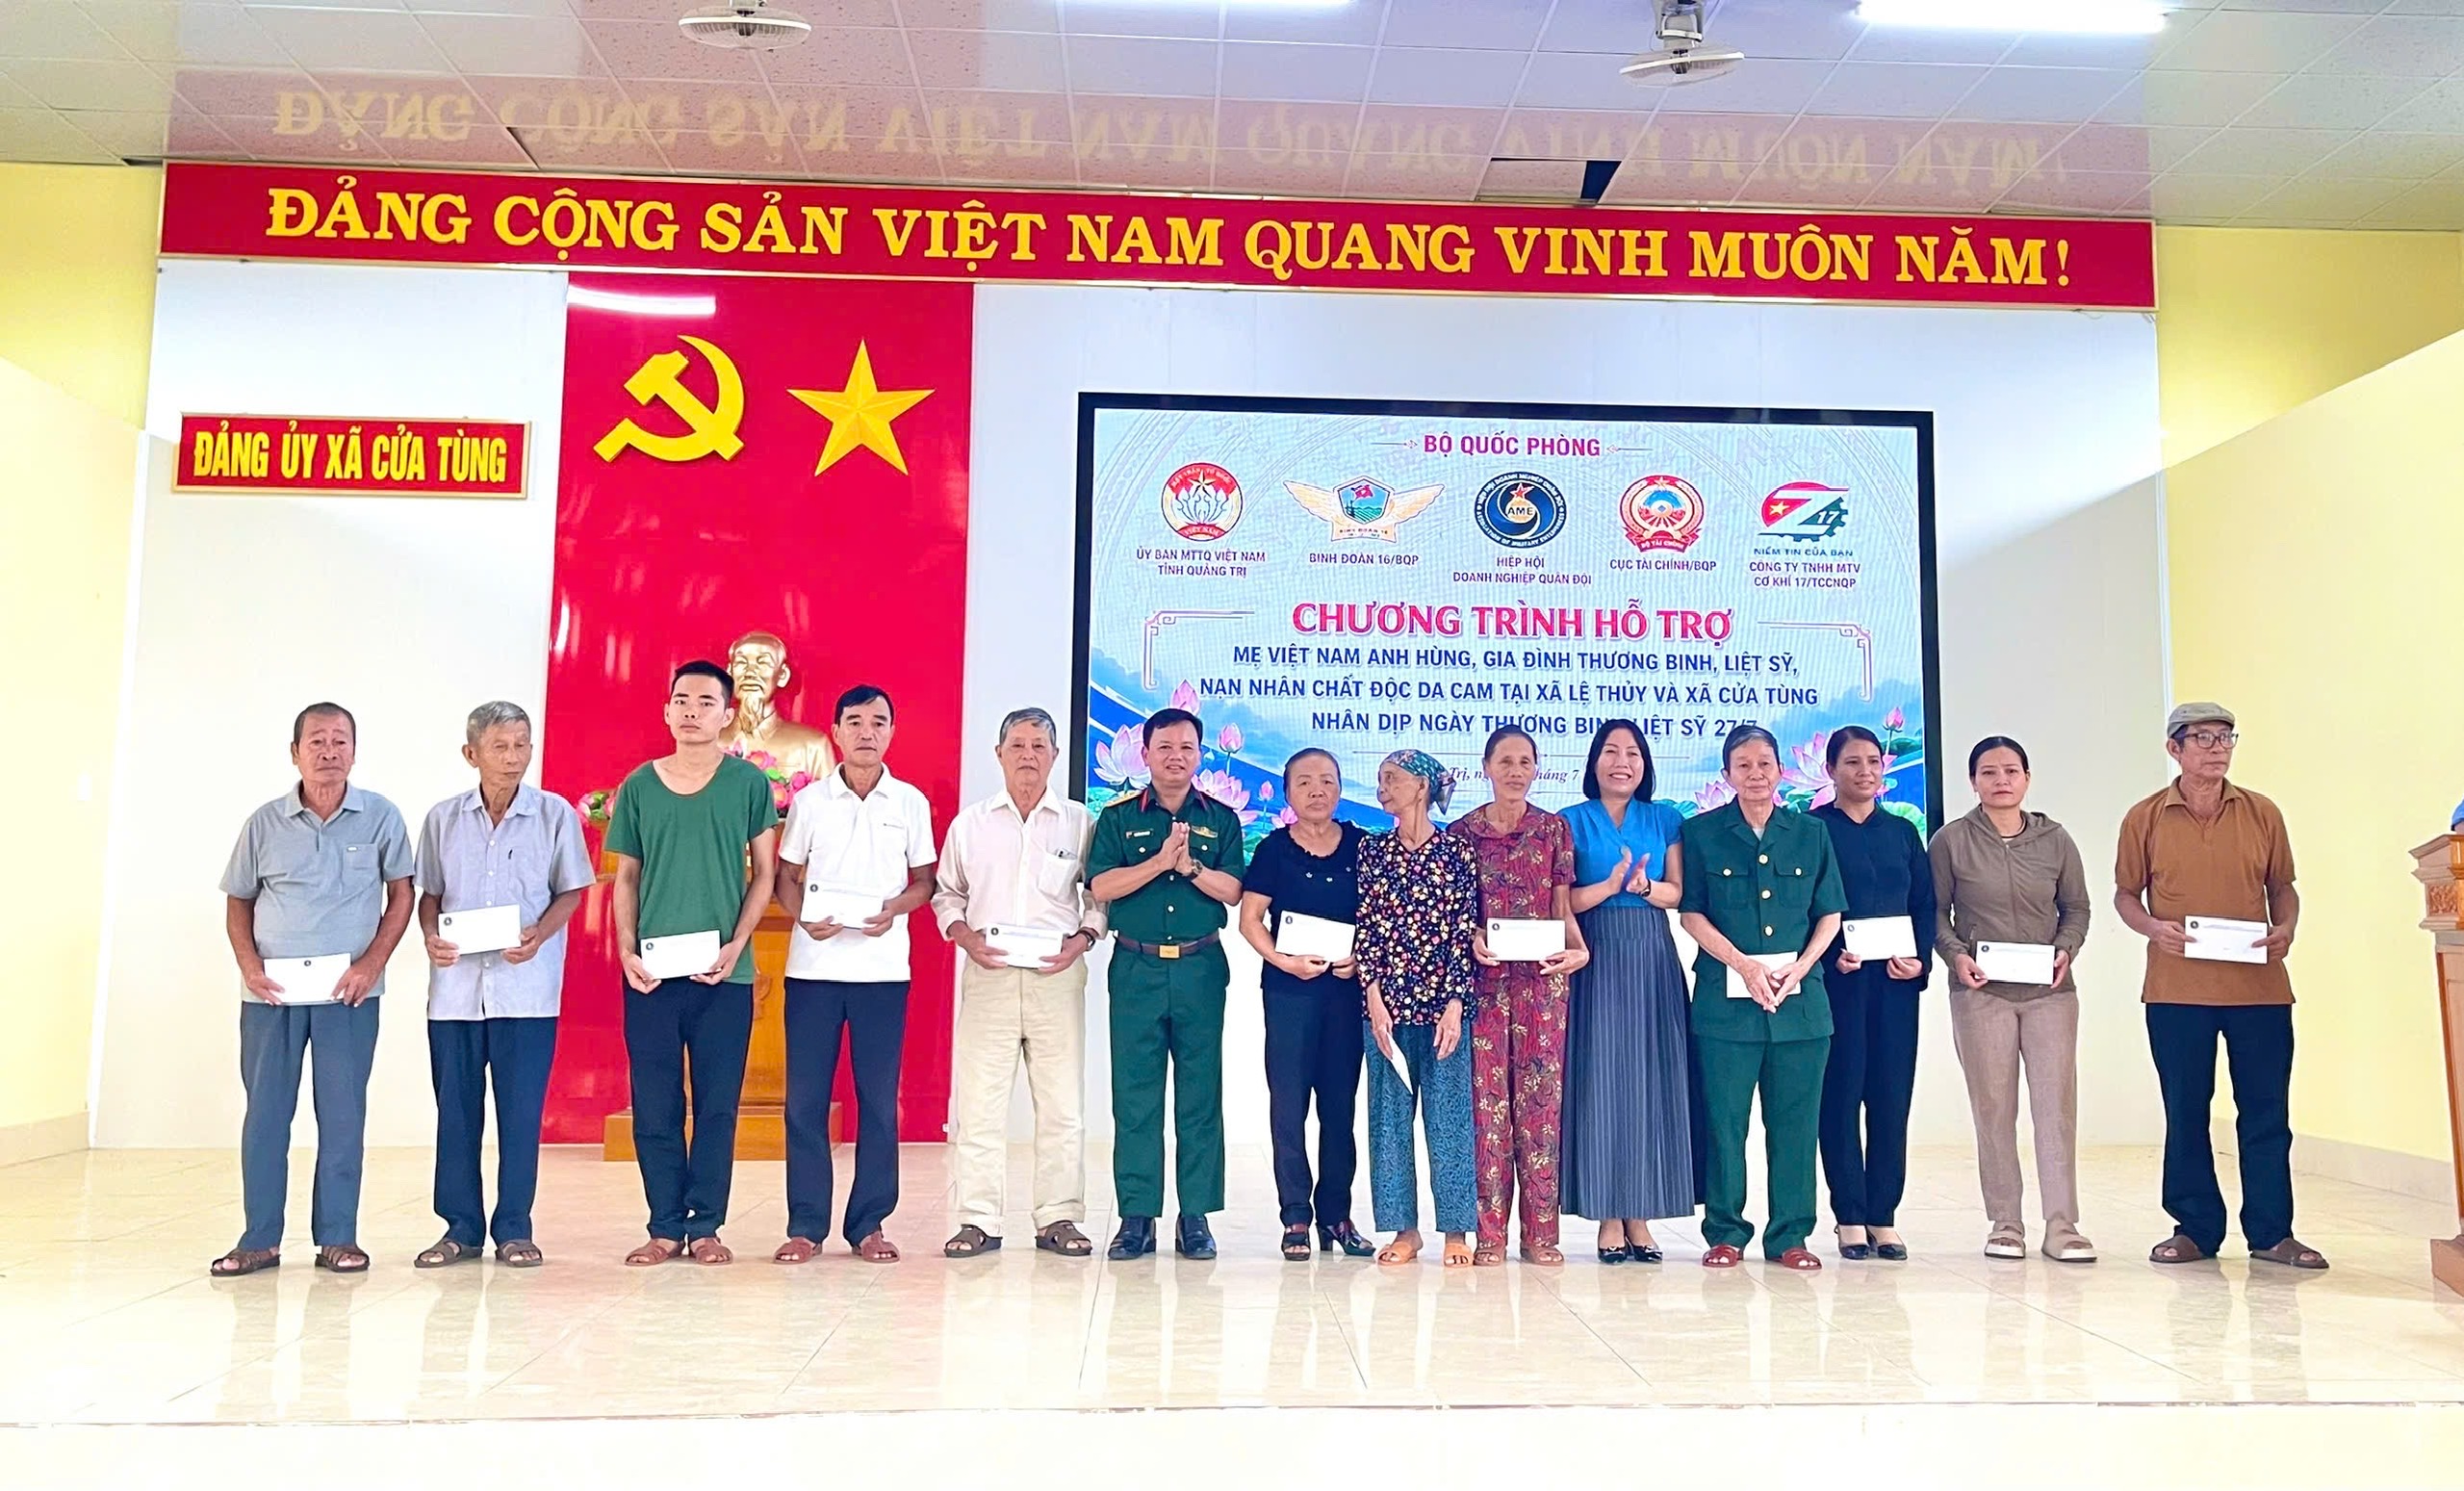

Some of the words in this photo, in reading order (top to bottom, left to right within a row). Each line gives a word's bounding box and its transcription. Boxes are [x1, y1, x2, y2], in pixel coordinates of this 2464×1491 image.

[266, 175, 472, 244] ĐẢNG
[494, 188, 680, 261] CỘNG
[700, 191, 848, 254] SẢN
[872, 199, 1046, 271] VIỆT
[1065, 215, 1224, 267] NAM
[1245, 220, 1476, 280] QUANG
[1494, 227, 1668, 277] VINH
[1688, 223, 1874, 281] MUÔN
[1424, 430, 1452, 457] BỘ
[1460, 430, 1519, 456] QUỐC
[1527, 433, 1600, 456] PHÒNG
[193, 421, 270, 477] ĐẢNG
[280, 420, 318, 479] ỦY
[323, 425, 364, 480] XÃ
[372, 424, 425, 481] CỬA
[437, 429, 507, 483] TÙNG
[1507, 506, 1533, 516] AME
[1155, 550, 1177, 560] BAN
[1181, 550, 1212, 561] MTTQ
[1215, 548, 1238, 563] VIỆT
[1241, 552, 1266, 561] NAM
[1309, 553, 1337, 564] BINH
[1341, 552, 1373, 564] ĐOÀN
[1378, 554, 1419, 566] 16/BQP
[1497, 555, 1522, 569] HIỆP
[1526, 555, 1545, 570] HỘI
[1230, 566, 1246, 578] TRỊ
[1609, 558, 1633, 571] CỤC
[1636, 557, 1652, 570] TÀI
[1655, 557, 1716, 572] CHÍNH/BQP
[1784, 562, 1798, 573] TY
[1802, 562, 1834, 573] TNHH
[1836, 563, 1861, 574] MTV
[1453, 572, 1492, 583] DOANH
[1495, 571, 1535, 585] NGHIỆP
[1538, 571, 1570, 584] QUÂN
[1573, 573, 1592, 586] ĐỘI
[1754, 575, 1770, 587] CƠ
[1773, 574, 1792, 587] KHÍ
[1795, 577, 1857, 589] 17/TCCNQP
[1293, 601, 1461, 635] CHƯƠNG
[1472, 599, 1582, 637] TRÌNH
[1594, 598, 1648, 639] HỖ
[1656, 608, 1732, 647] TRỢ
[1233, 646, 1262, 667] MẸ
[1268, 643, 1309, 667] VIỆT
[1317, 647, 1360, 664] NAM
[1367, 648, 1408, 665] ANH
[1416, 645, 1476, 669] HÙNG,
[1483, 650, 1516, 667] GIA
[1523, 648, 1570, 668] ĐÌNH
[1578, 651, 1658, 670] THƯƠNG
[1666, 654, 1718, 674] BINH,
[1724, 651, 1762, 676] LIỆT
[1768, 652, 1798, 676] SỸ,
[1200, 678, 1242, 699] NẠN
[1249, 675, 1306, 696] NHÂN
[1312, 673, 1363, 698] CHẤT
[1369, 677, 1411, 702] ĐỘC
[1418, 681, 1445, 699] DA
[1450, 682, 1493, 700] CAM
[1500, 683, 1529, 705] TẠI
[1536, 680, 1562, 702] XÃ
[1569, 681, 1589, 706] LỆ
[1596, 681, 1647, 703] THỦY
[1654, 681, 1679, 704] VÀ
[1685, 682, 1711, 704] XÃ
[1718, 681, 1759, 705] CỬA
[1765, 683, 1818, 705] TÙNG
[1312, 708, 1370, 731] NHÂN
[1378, 712, 1411, 734] DỊP
[1420, 710, 1475, 733] NGÀY
[1575, 717, 1609, 734] BIN
[1633, 714, 1674, 740] IỆT
[1681, 714, 1707, 736] SỸ
[1535, 768, 1569, 783] háng
[1572, 769, 1579, 781] 7
